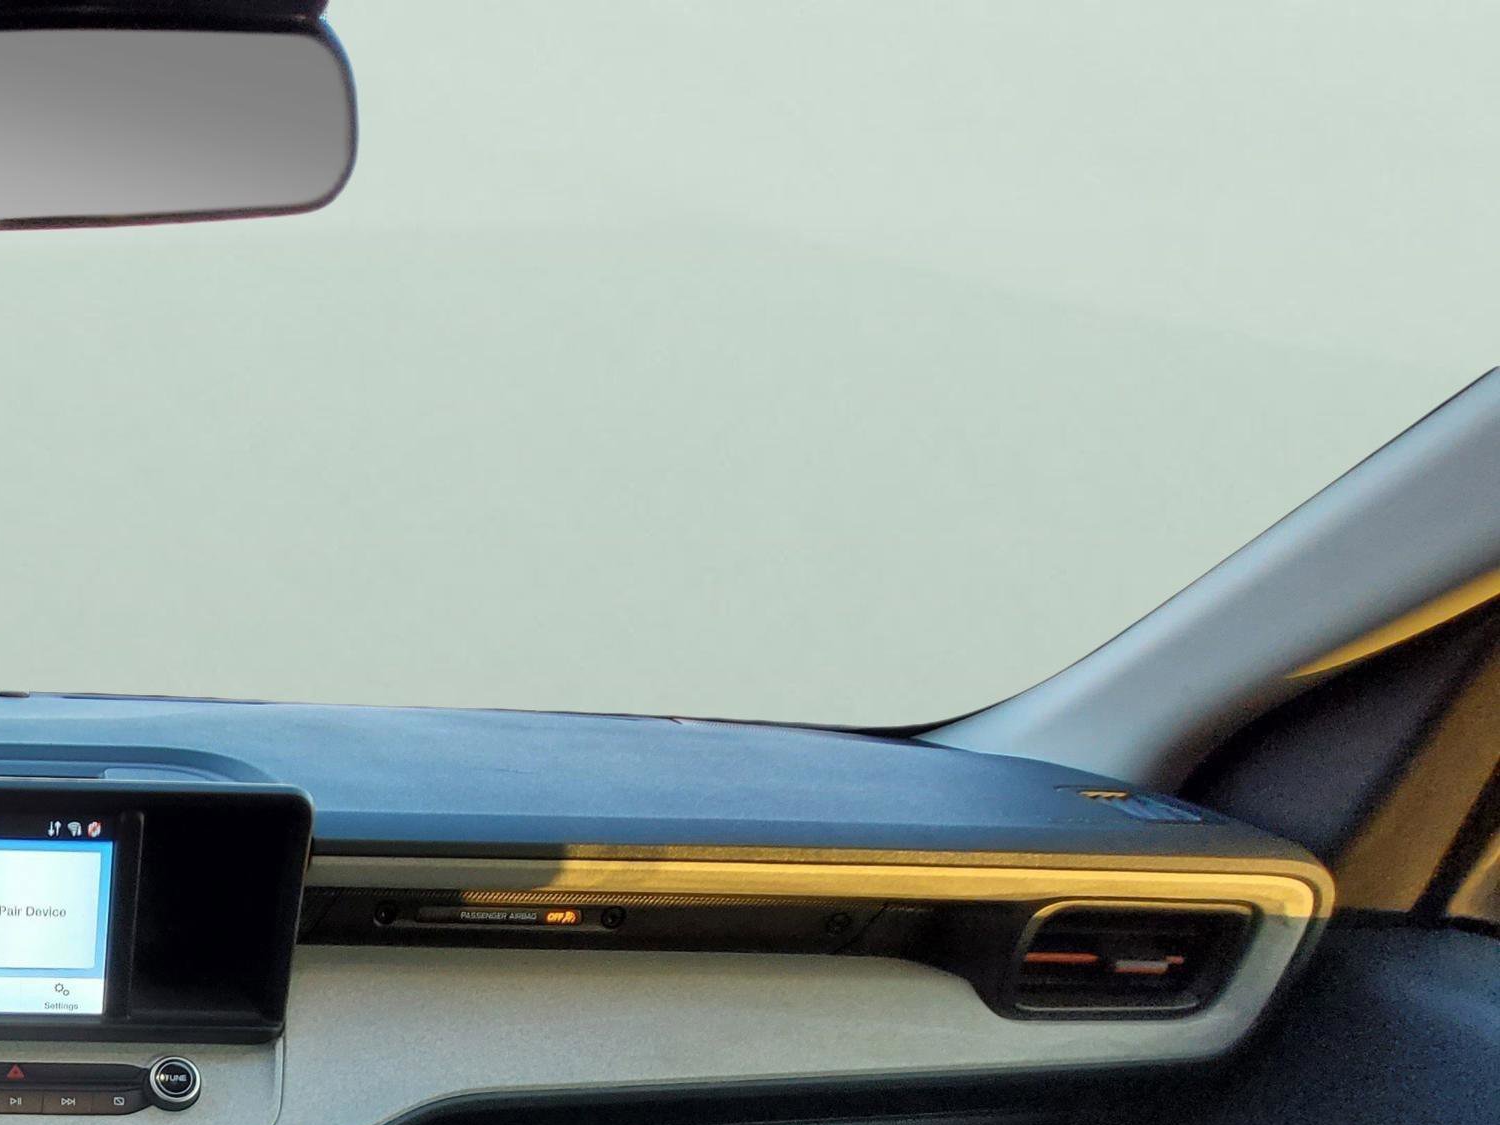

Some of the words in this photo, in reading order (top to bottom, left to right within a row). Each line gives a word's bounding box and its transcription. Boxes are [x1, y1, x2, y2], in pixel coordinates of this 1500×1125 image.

[26, 906, 67, 918] Device
[460, 911, 507, 920] PASSENGER
[509, 912, 537, 920] AIRBAG
[44, 1001, 79, 1011] Settings
[164, 1074, 187, 1082] TUNE
